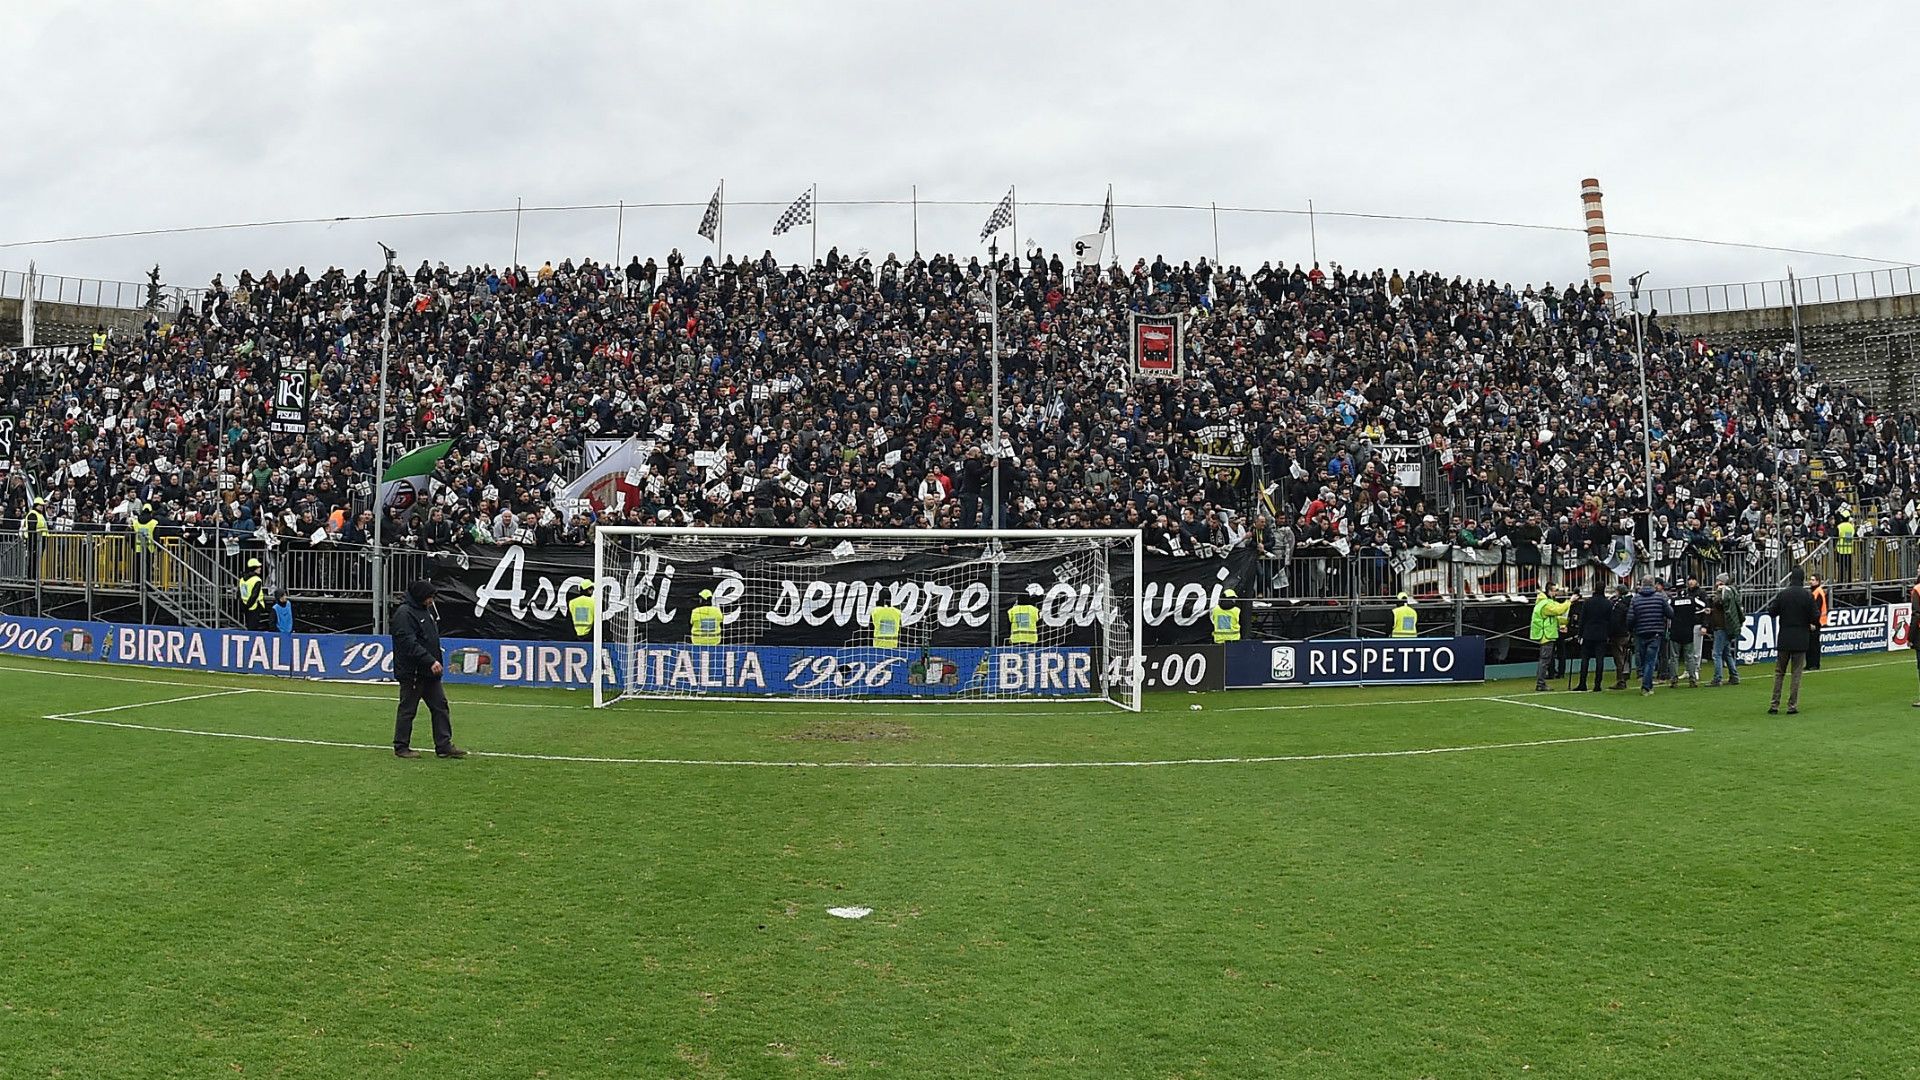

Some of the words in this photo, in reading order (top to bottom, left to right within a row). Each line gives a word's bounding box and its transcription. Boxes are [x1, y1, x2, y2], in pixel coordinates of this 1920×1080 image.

[119, 628, 207, 666] BIRRA
[222, 634, 326, 673] ITALIA
[1737, 614, 1781, 650] SA
[499, 644, 617, 685] BIRRA
[636, 649, 766, 688] ITALIA
[1309, 646, 1455, 675] RISPETTO
